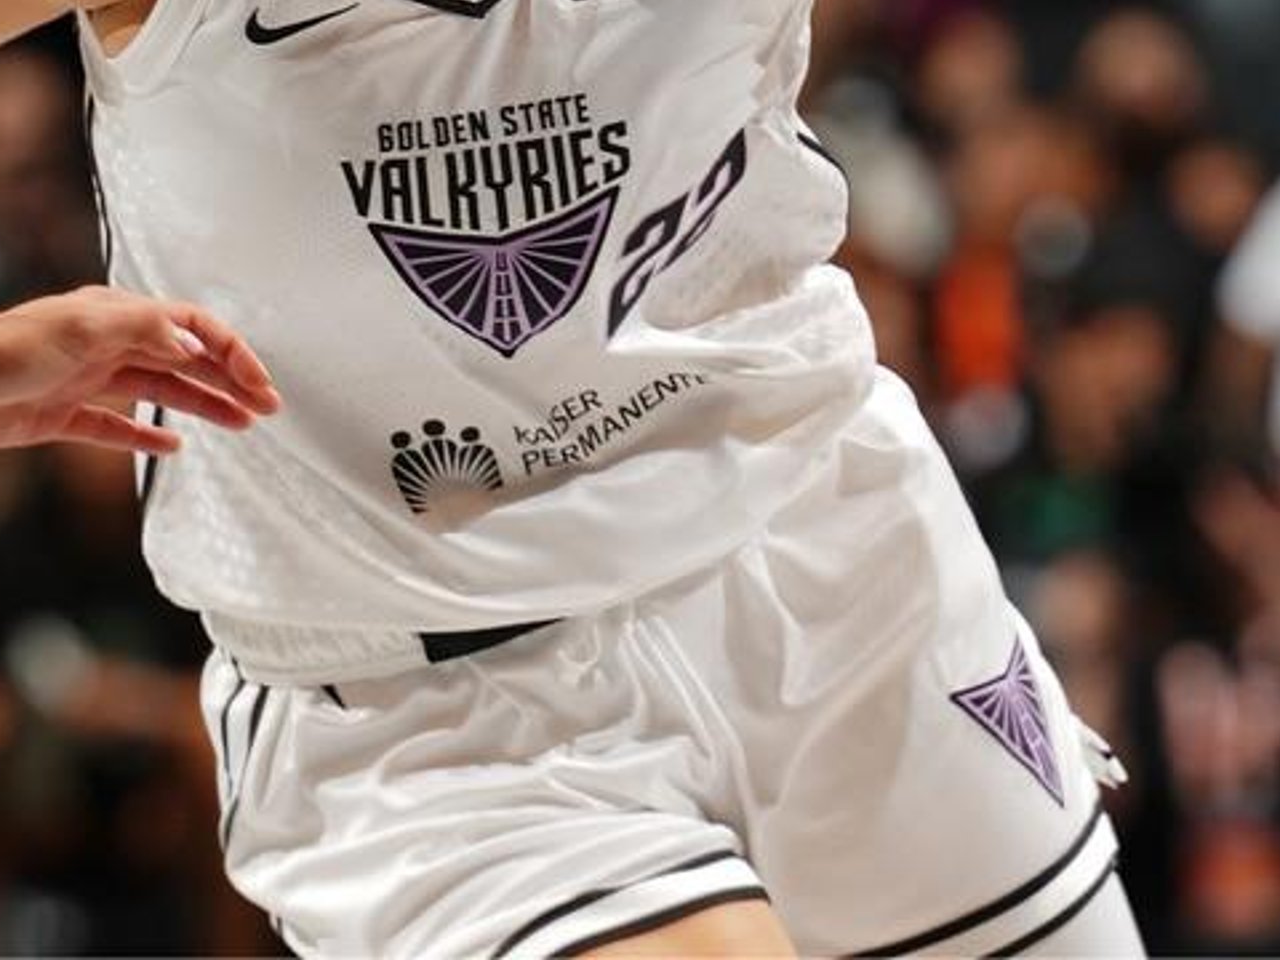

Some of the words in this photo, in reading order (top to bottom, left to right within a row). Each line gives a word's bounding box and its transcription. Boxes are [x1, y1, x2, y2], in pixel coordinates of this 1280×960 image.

[376, 109, 491, 154] GOLDEN
[499, 93, 591, 137] STATE
[340, 120, 632, 232] VALKYRIES
[512, 388, 604, 446] KAISER
